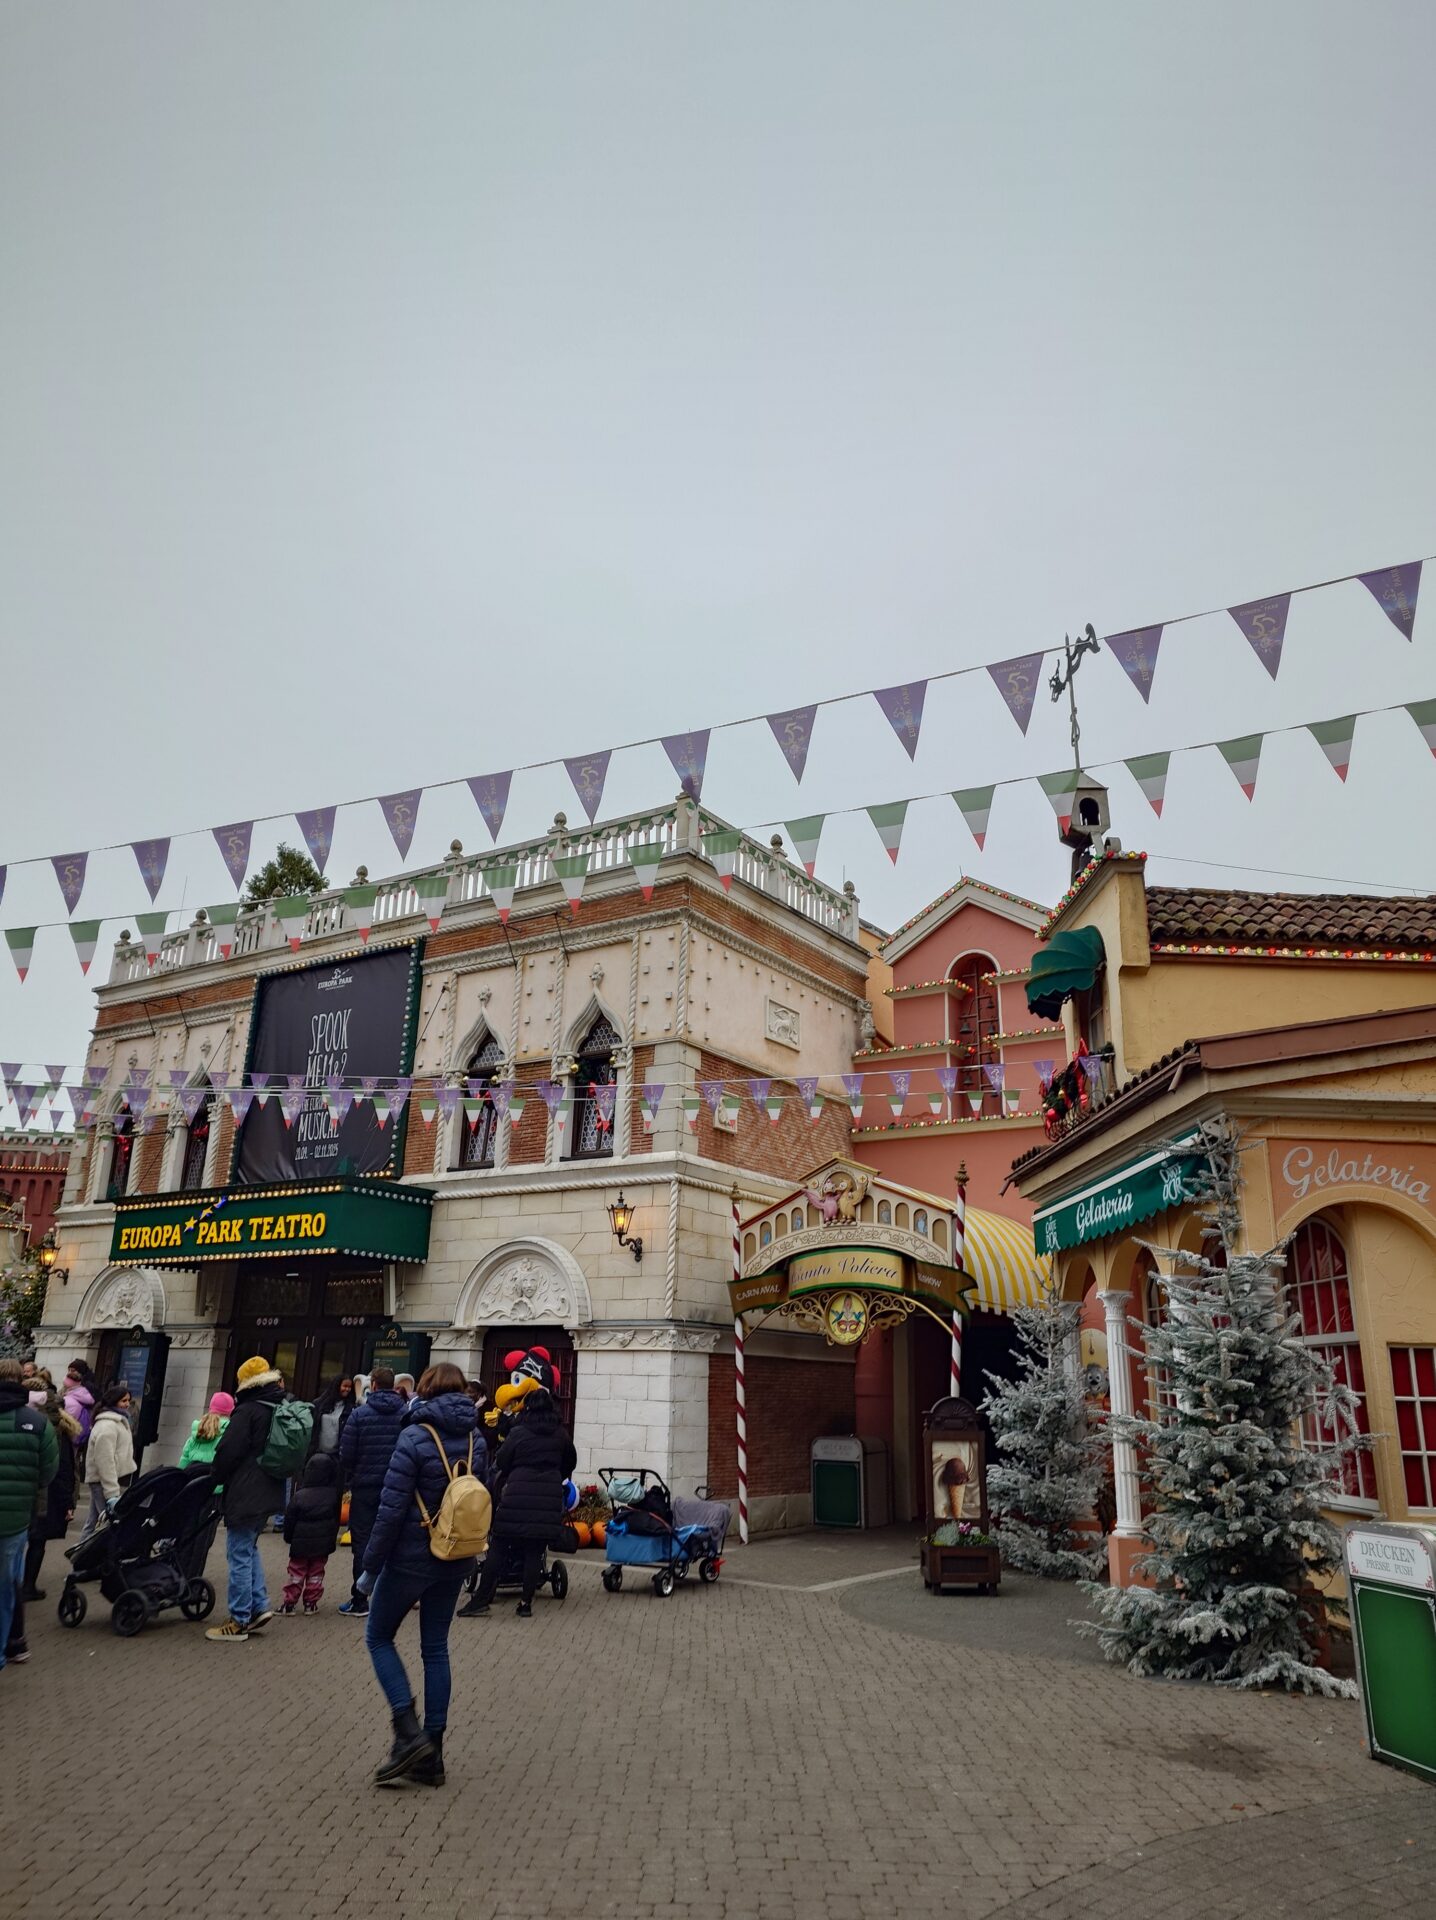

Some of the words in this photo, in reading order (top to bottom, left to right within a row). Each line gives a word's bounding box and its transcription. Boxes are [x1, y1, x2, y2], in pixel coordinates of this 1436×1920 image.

[338, 976, 353, 985] PARK
[308, 1008, 352, 1055] SPOOK
[297, 1111, 340, 1142] MUSICAL
[1283, 1145, 1432, 1203] Gelateria
[1076, 1188, 1134, 1238] Gelateria
[119, 1224, 182, 1250] EUROPA
[196, 1218, 244, 1245] PARK
[249, 1212, 326, 1241] TEATRO
[838, 1256, 898, 1279] Voliera
[735, 1284, 781, 1301] CARNAVAL
[1360, 1540, 1416, 1564] DRÜCKEN
[1366, 1559, 1391, 1572] PRESSE
[1394, 1563, 1414, 1577] PUSH
